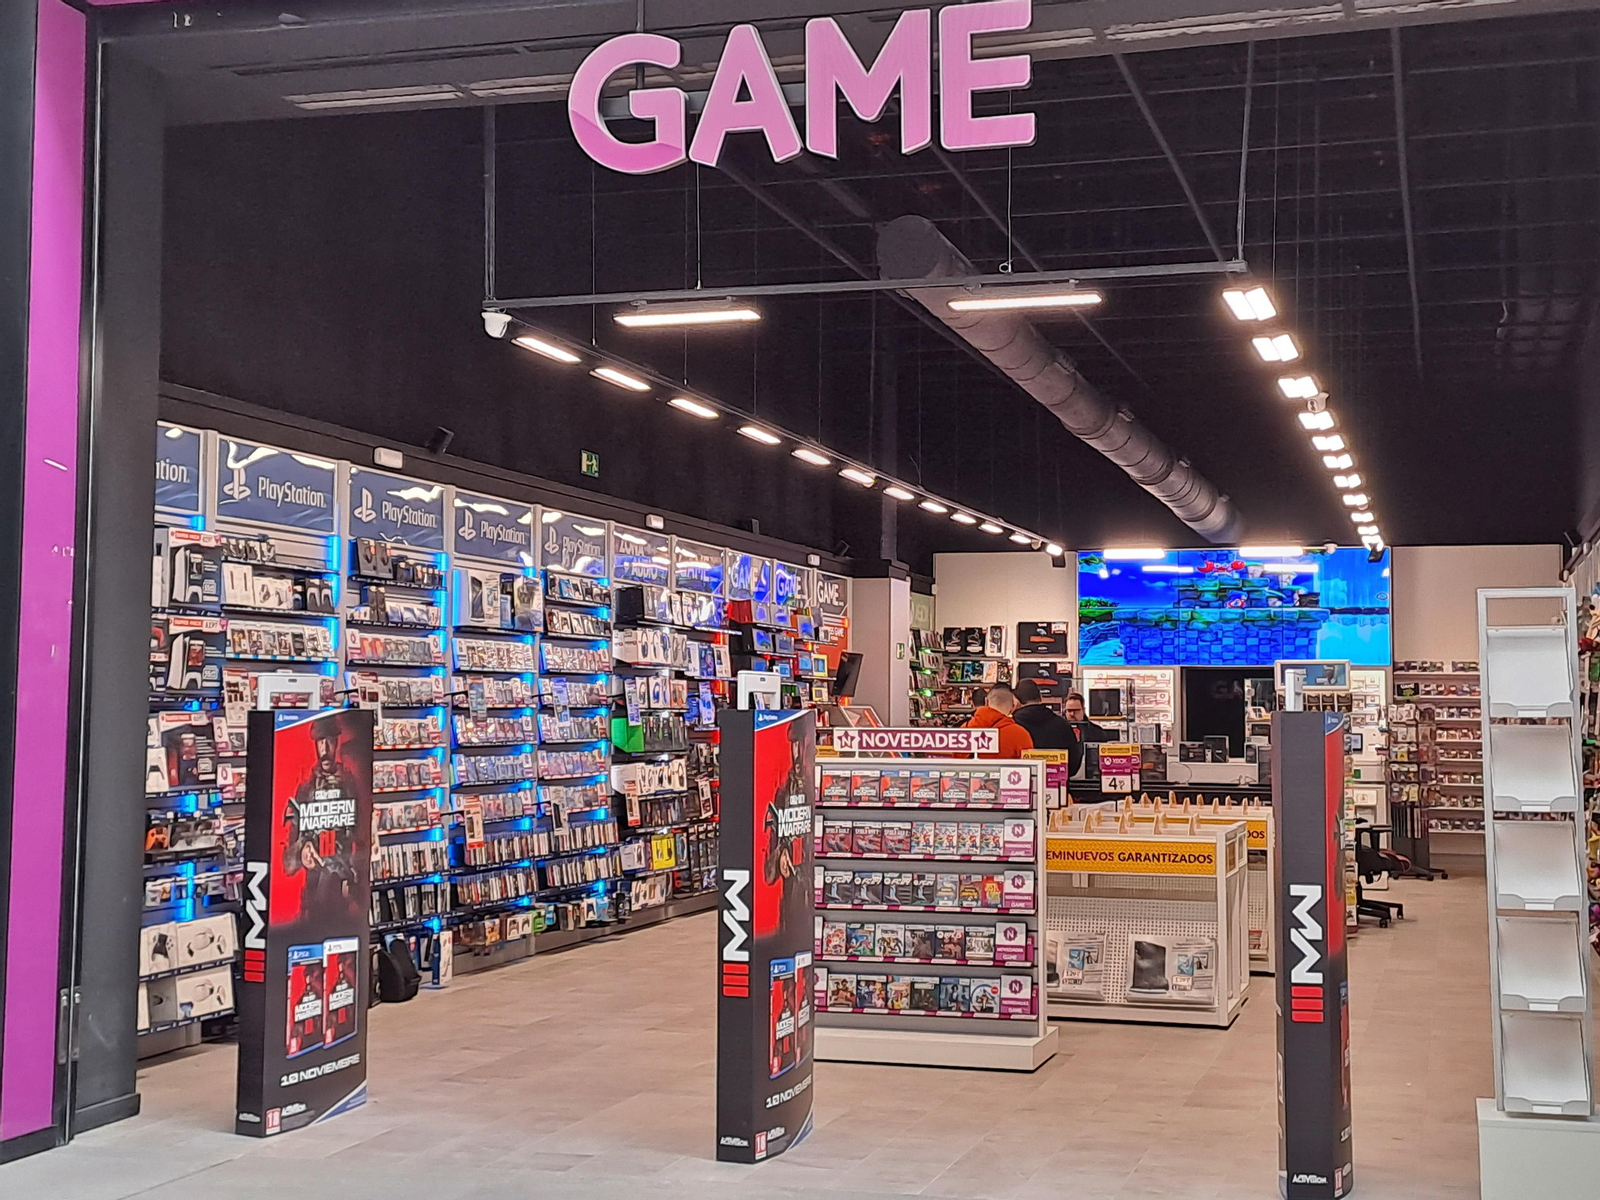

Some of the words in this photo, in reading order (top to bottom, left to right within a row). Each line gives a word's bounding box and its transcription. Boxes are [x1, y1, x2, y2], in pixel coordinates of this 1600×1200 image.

[567, 0, 1036, 174] GAME
[258, 476, 325, 508] PlayStation
[382, 500, 436, 528] PlayStation
[480, 520, 525, 545] PlayStation
[731, 564, 758, 592] GAME
[817, 580, 839, 606] GAME
[862, 732, 968, 749] NOVEDADES
[300, 799, 355, 817] MODERN
[778, 805, 812, 823] MODERN
[300, 813, 355, 830] WARFARE
[778, 821, 811, 837] WARFARE
[1046, 850, 1114, 862] EMINUEVOS
[1117, 851, 1214, 865] GARANTIZADOS
[300, 1053, 360, 1082] NOVIEMBRE
[1292, 1173, 1328, 1185] ACTIVISION
